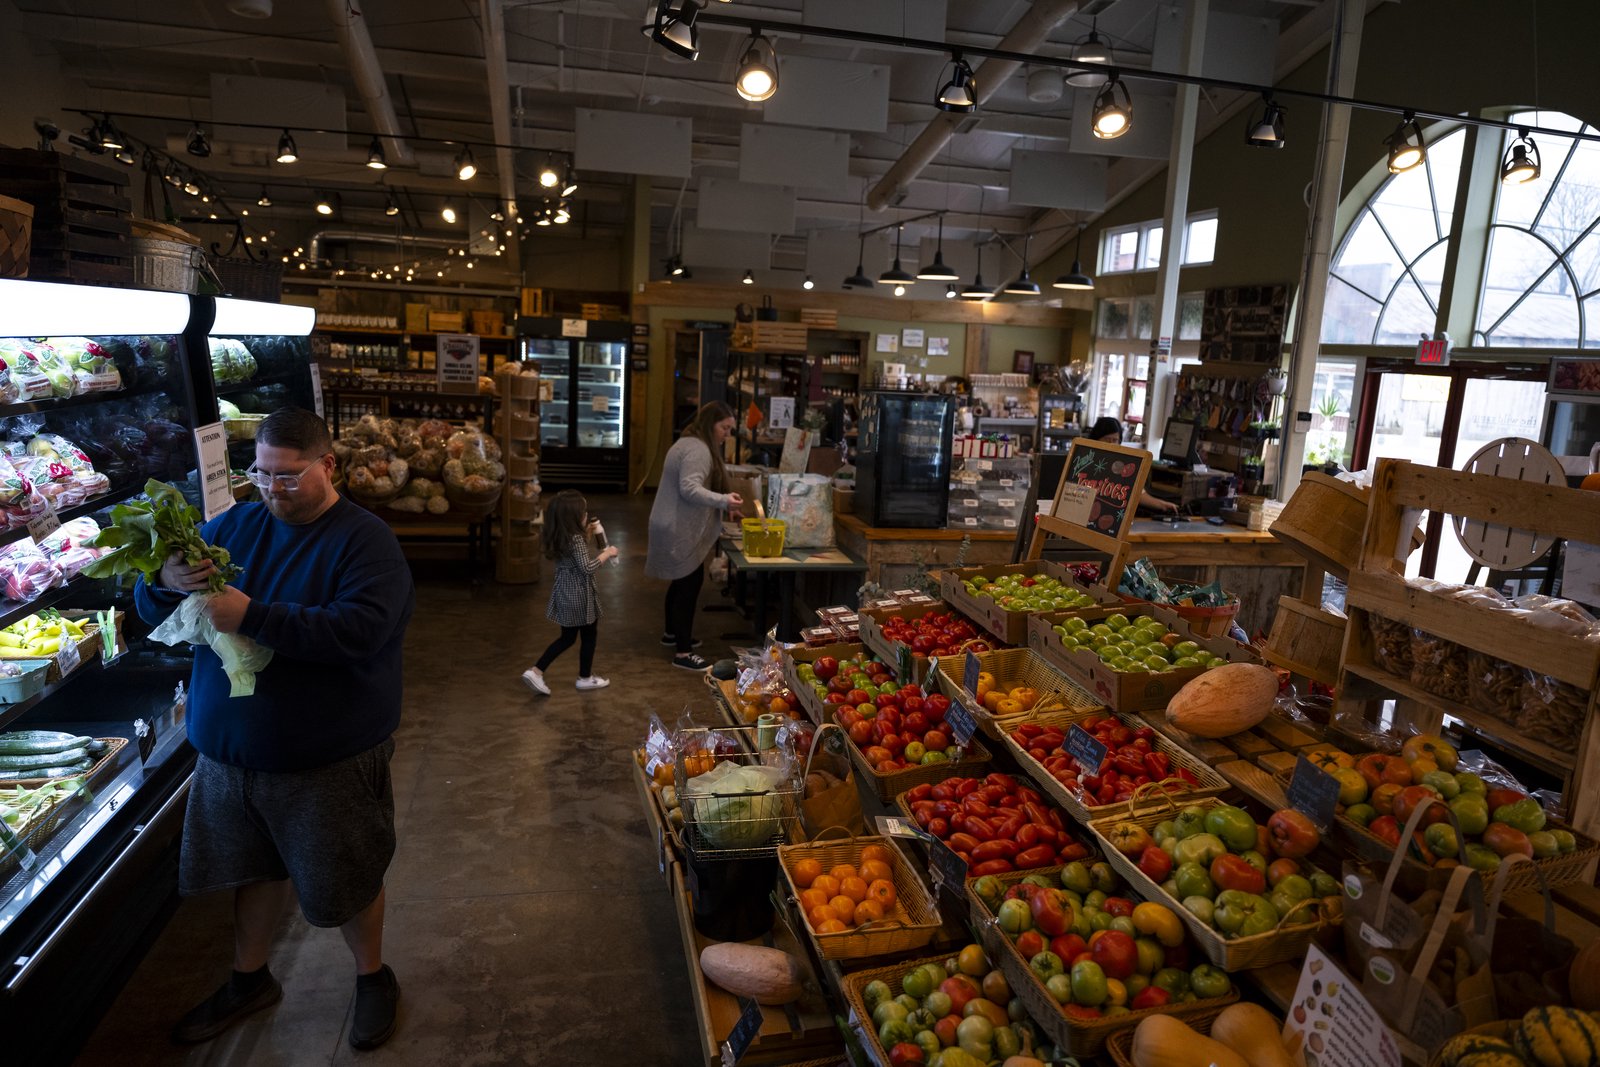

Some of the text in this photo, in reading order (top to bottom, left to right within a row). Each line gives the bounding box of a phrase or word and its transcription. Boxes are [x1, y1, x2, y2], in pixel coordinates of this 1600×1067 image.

[1421, 342, 1443, 362] EXIT
[202, 432, 220, 443] ATTENTION
[207, 468, 226, 481] GREEN STICK
[1337, 1006, 1364, 1037] Acorn Squash
[1340, 994, 1373, 1034] Spaghetti Squash
[1361, 1003, 1374, 1022] Squash
